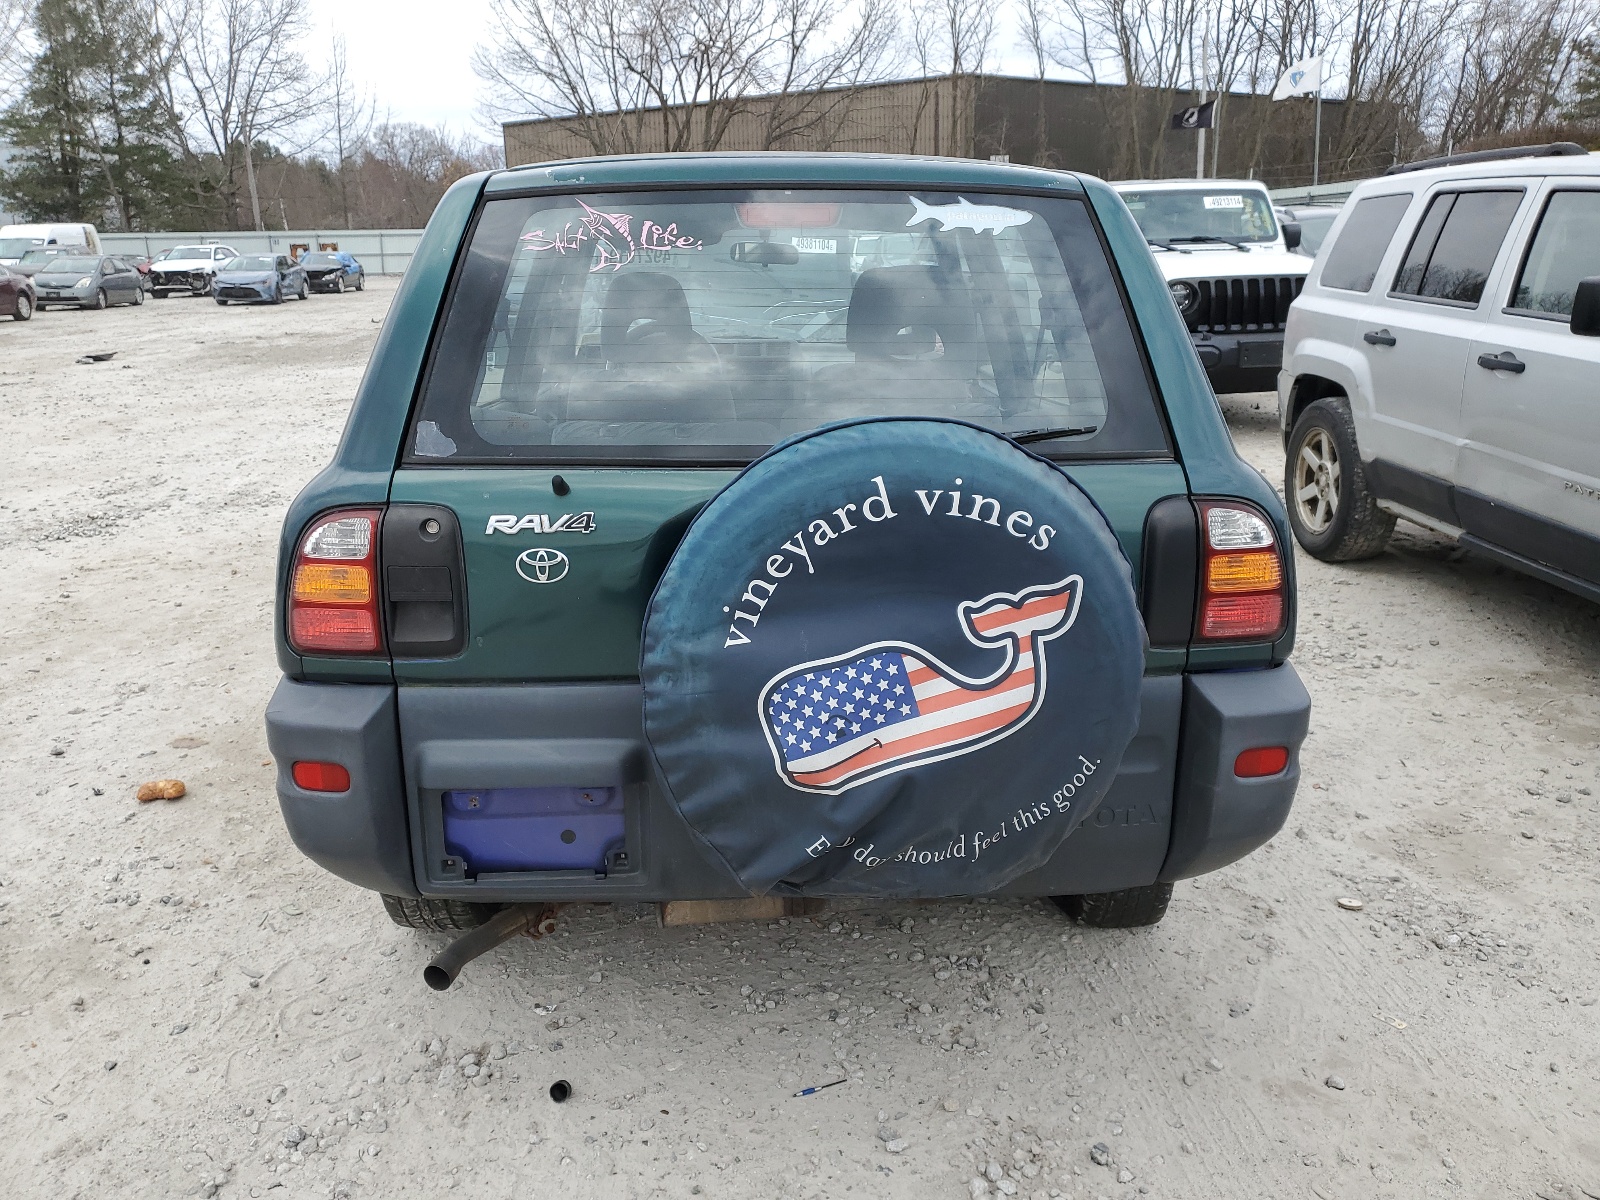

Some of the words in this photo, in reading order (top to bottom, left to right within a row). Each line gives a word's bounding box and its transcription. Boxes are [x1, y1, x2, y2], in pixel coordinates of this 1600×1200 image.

[485, 511, 596, 535] RAV4
[723, 475, 898, 649] vineyard
[915, 477, 1056, 551] vines
[894, 834, 966, 865] should
[971, 822, 1009, 862] feel
[1012, 802, 1051, 832] this
[1053, 754, 1101, 813] good.
